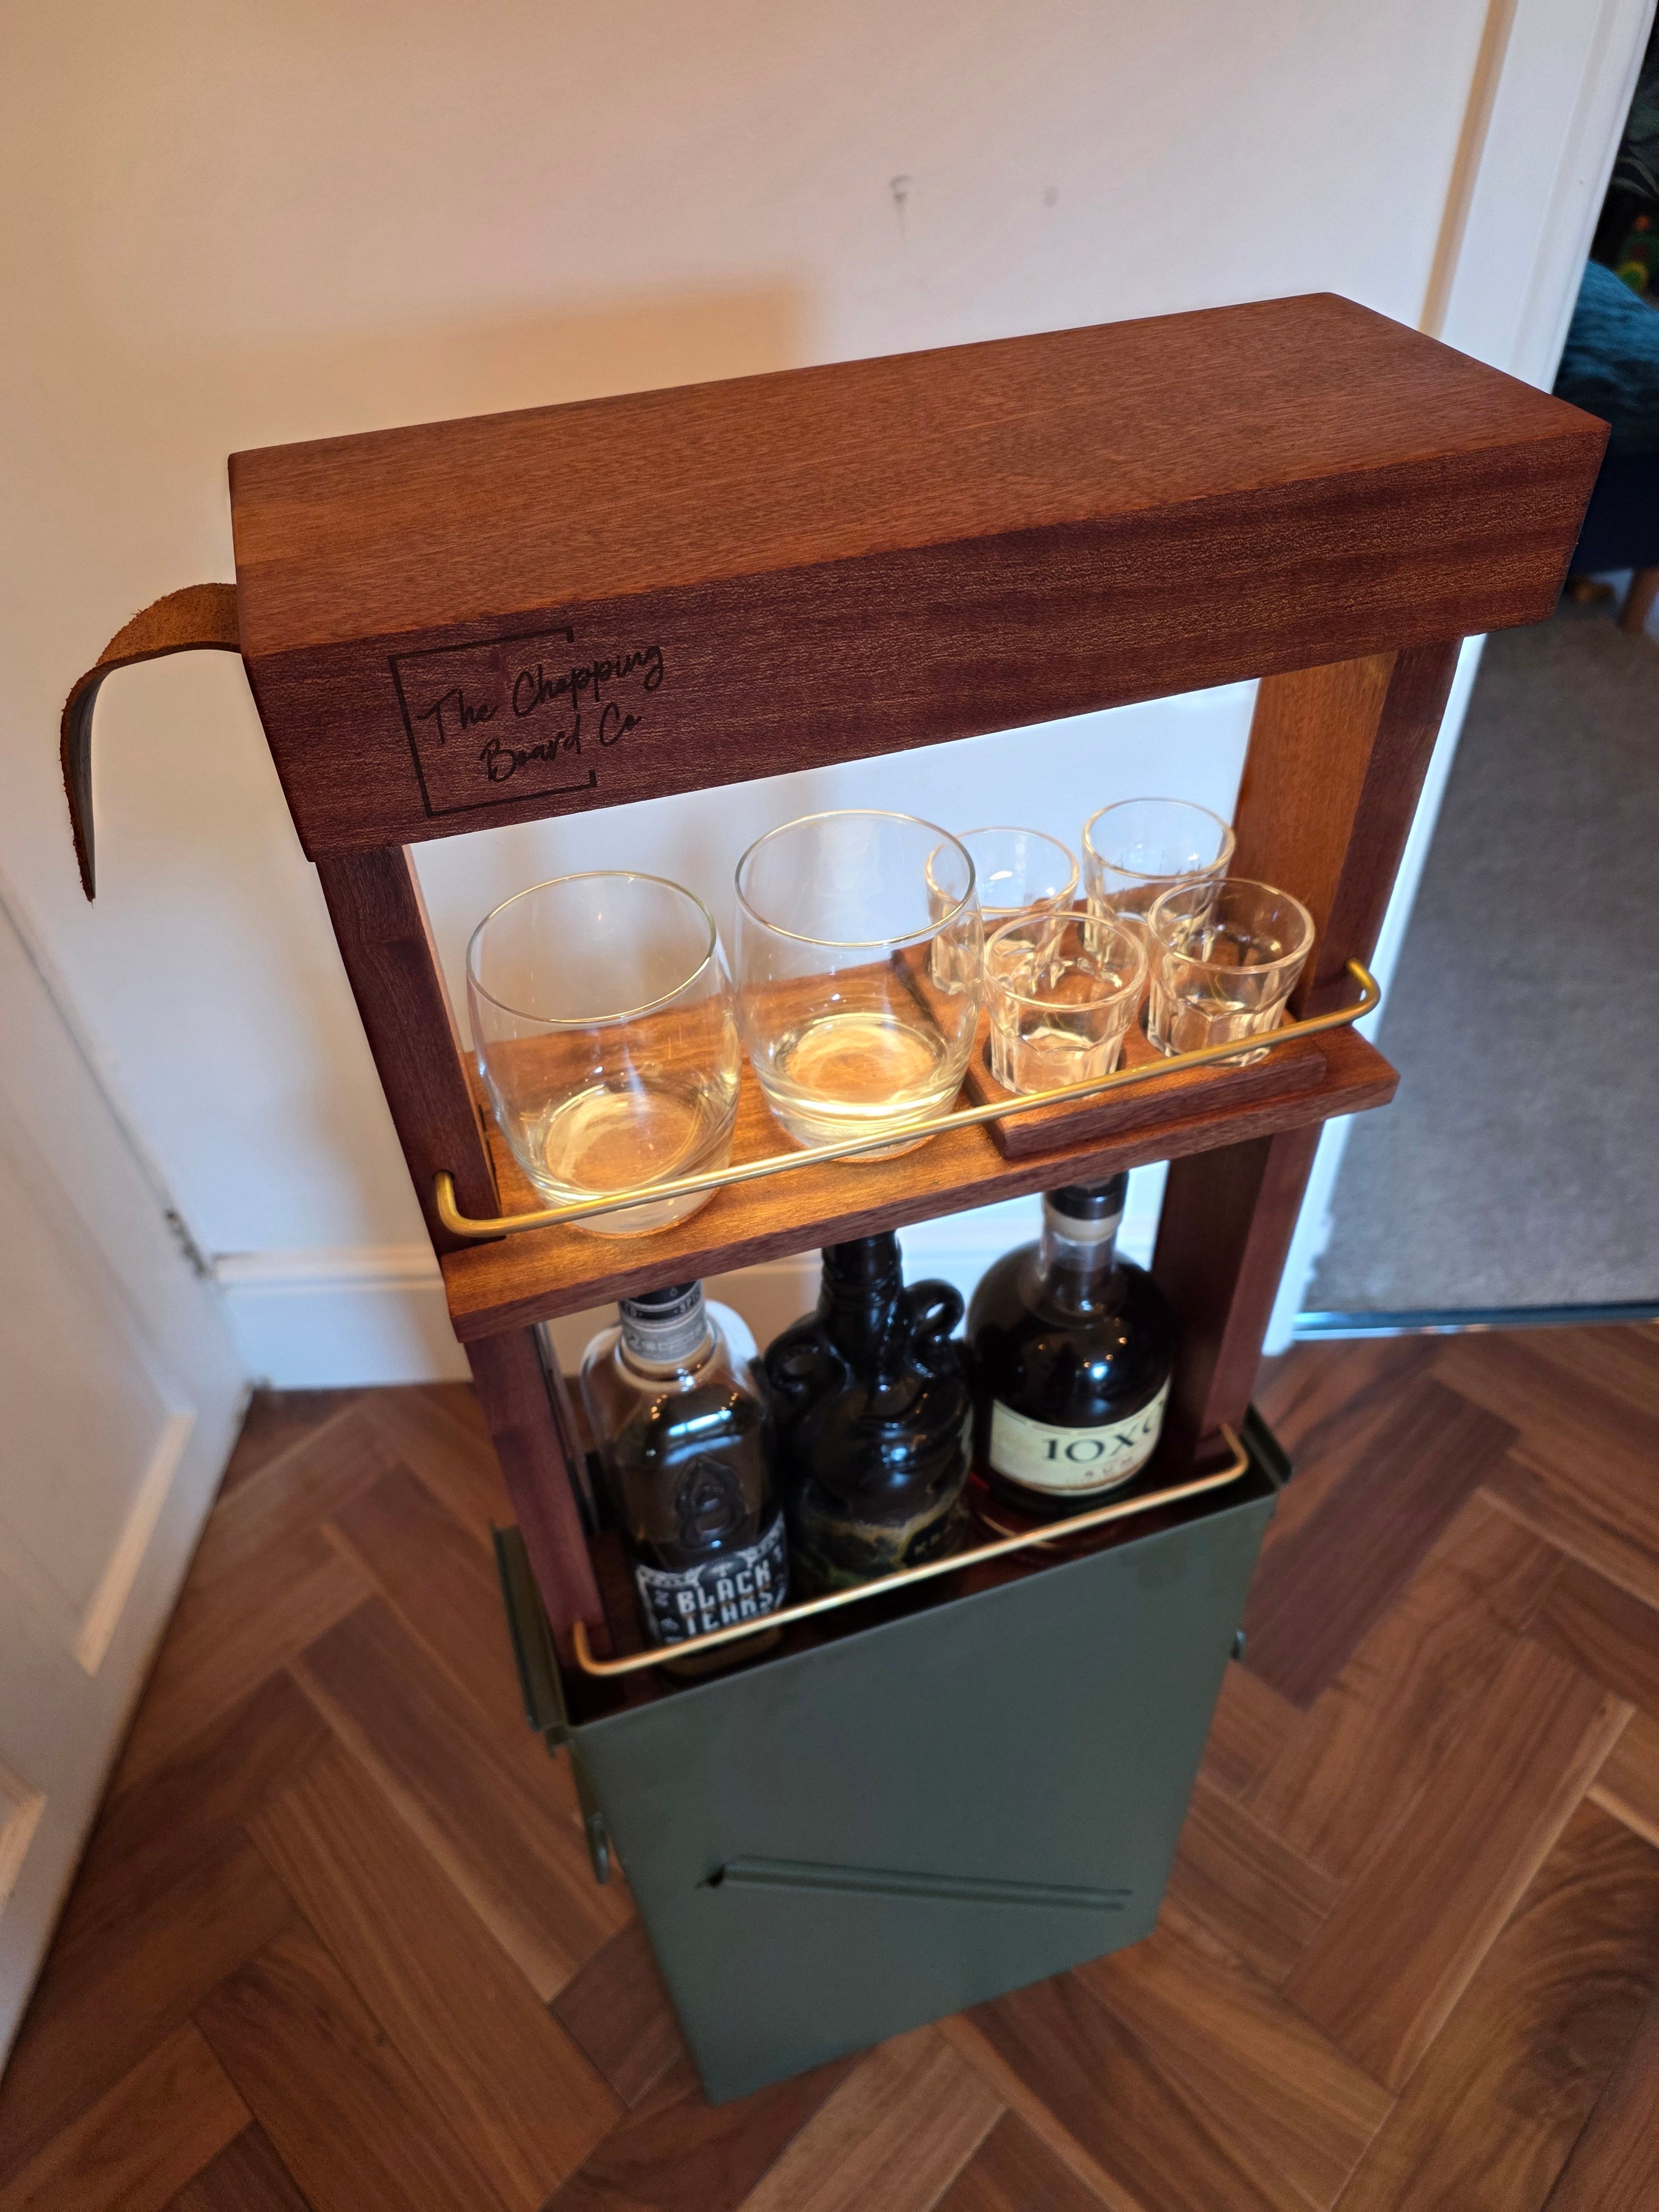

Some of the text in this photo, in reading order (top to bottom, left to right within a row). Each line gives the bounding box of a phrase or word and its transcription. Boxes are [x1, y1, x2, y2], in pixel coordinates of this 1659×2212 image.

[417, 645, 664, 744] The Chopping
[479, 701, 643, 782] Board Co
[676, 1559, 771, 1614] BLACK
